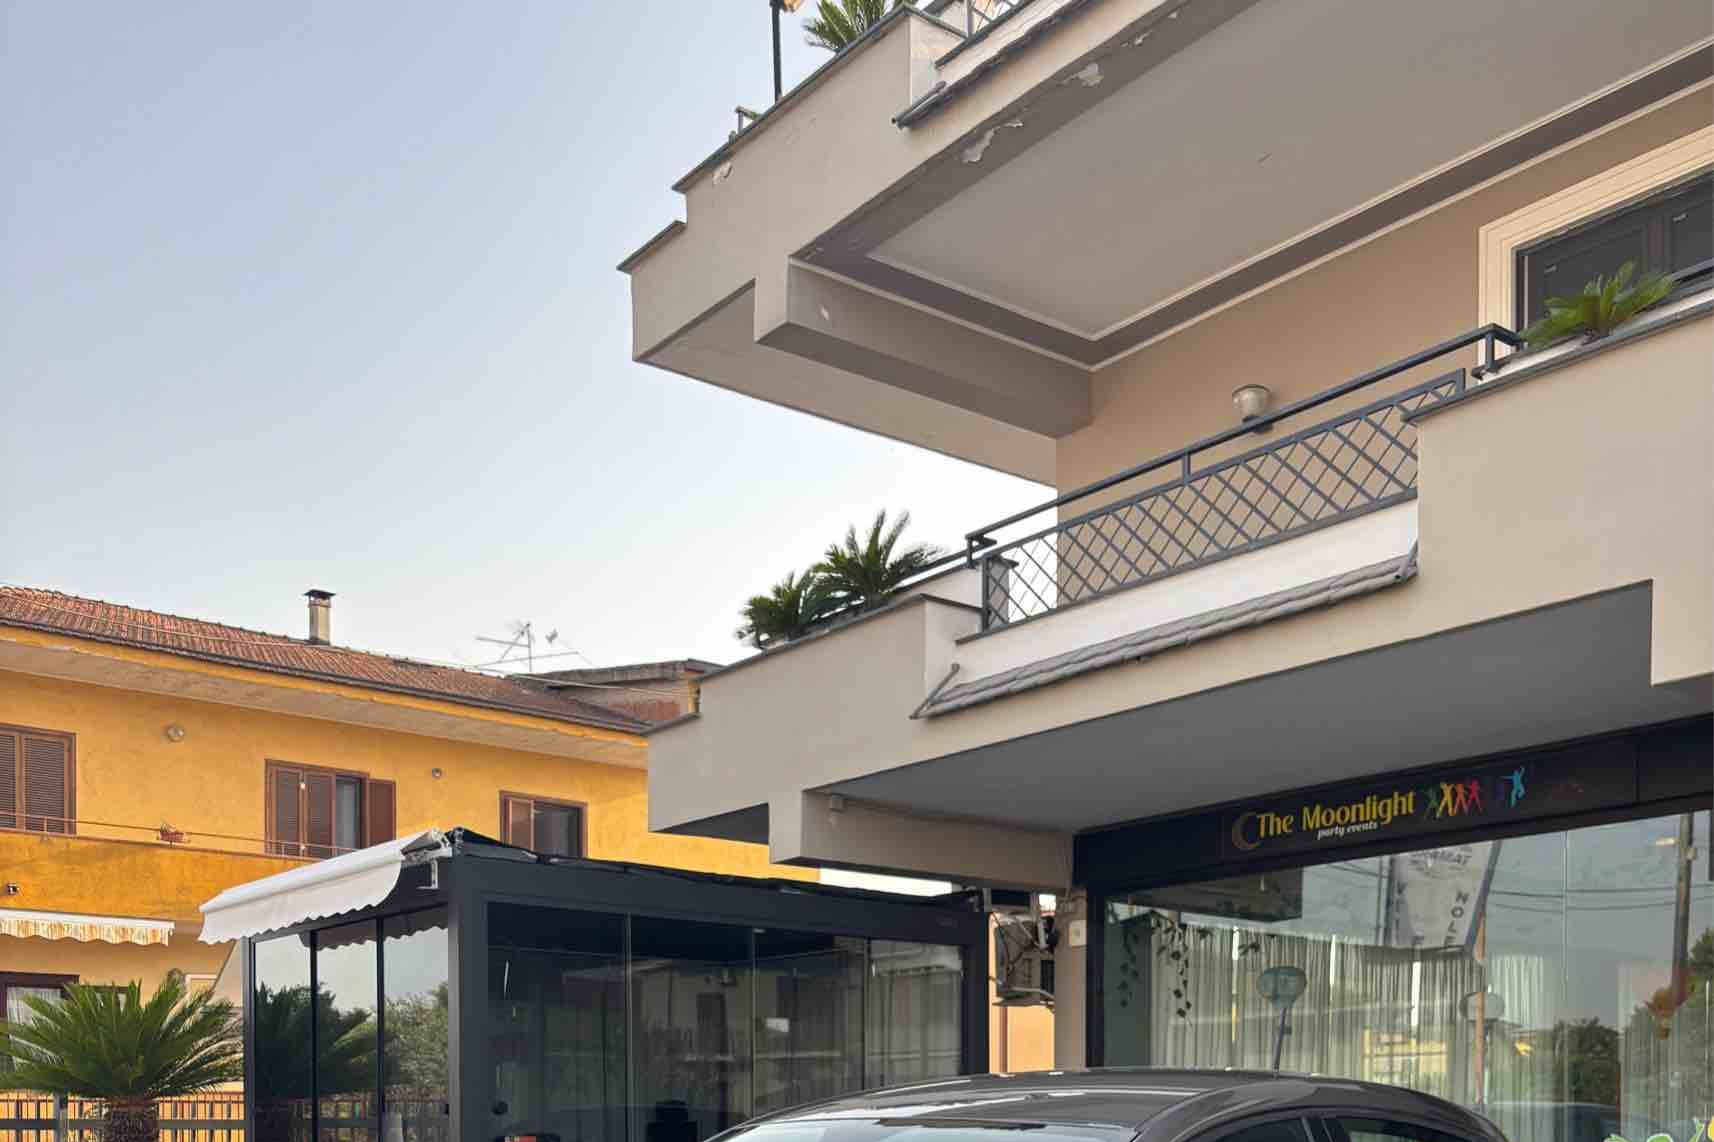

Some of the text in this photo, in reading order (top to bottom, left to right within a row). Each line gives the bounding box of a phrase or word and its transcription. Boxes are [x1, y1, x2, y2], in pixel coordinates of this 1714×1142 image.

[1256, 791, 1415, 839] The Moonlight
[1316, 820, 1379, 841] party events
